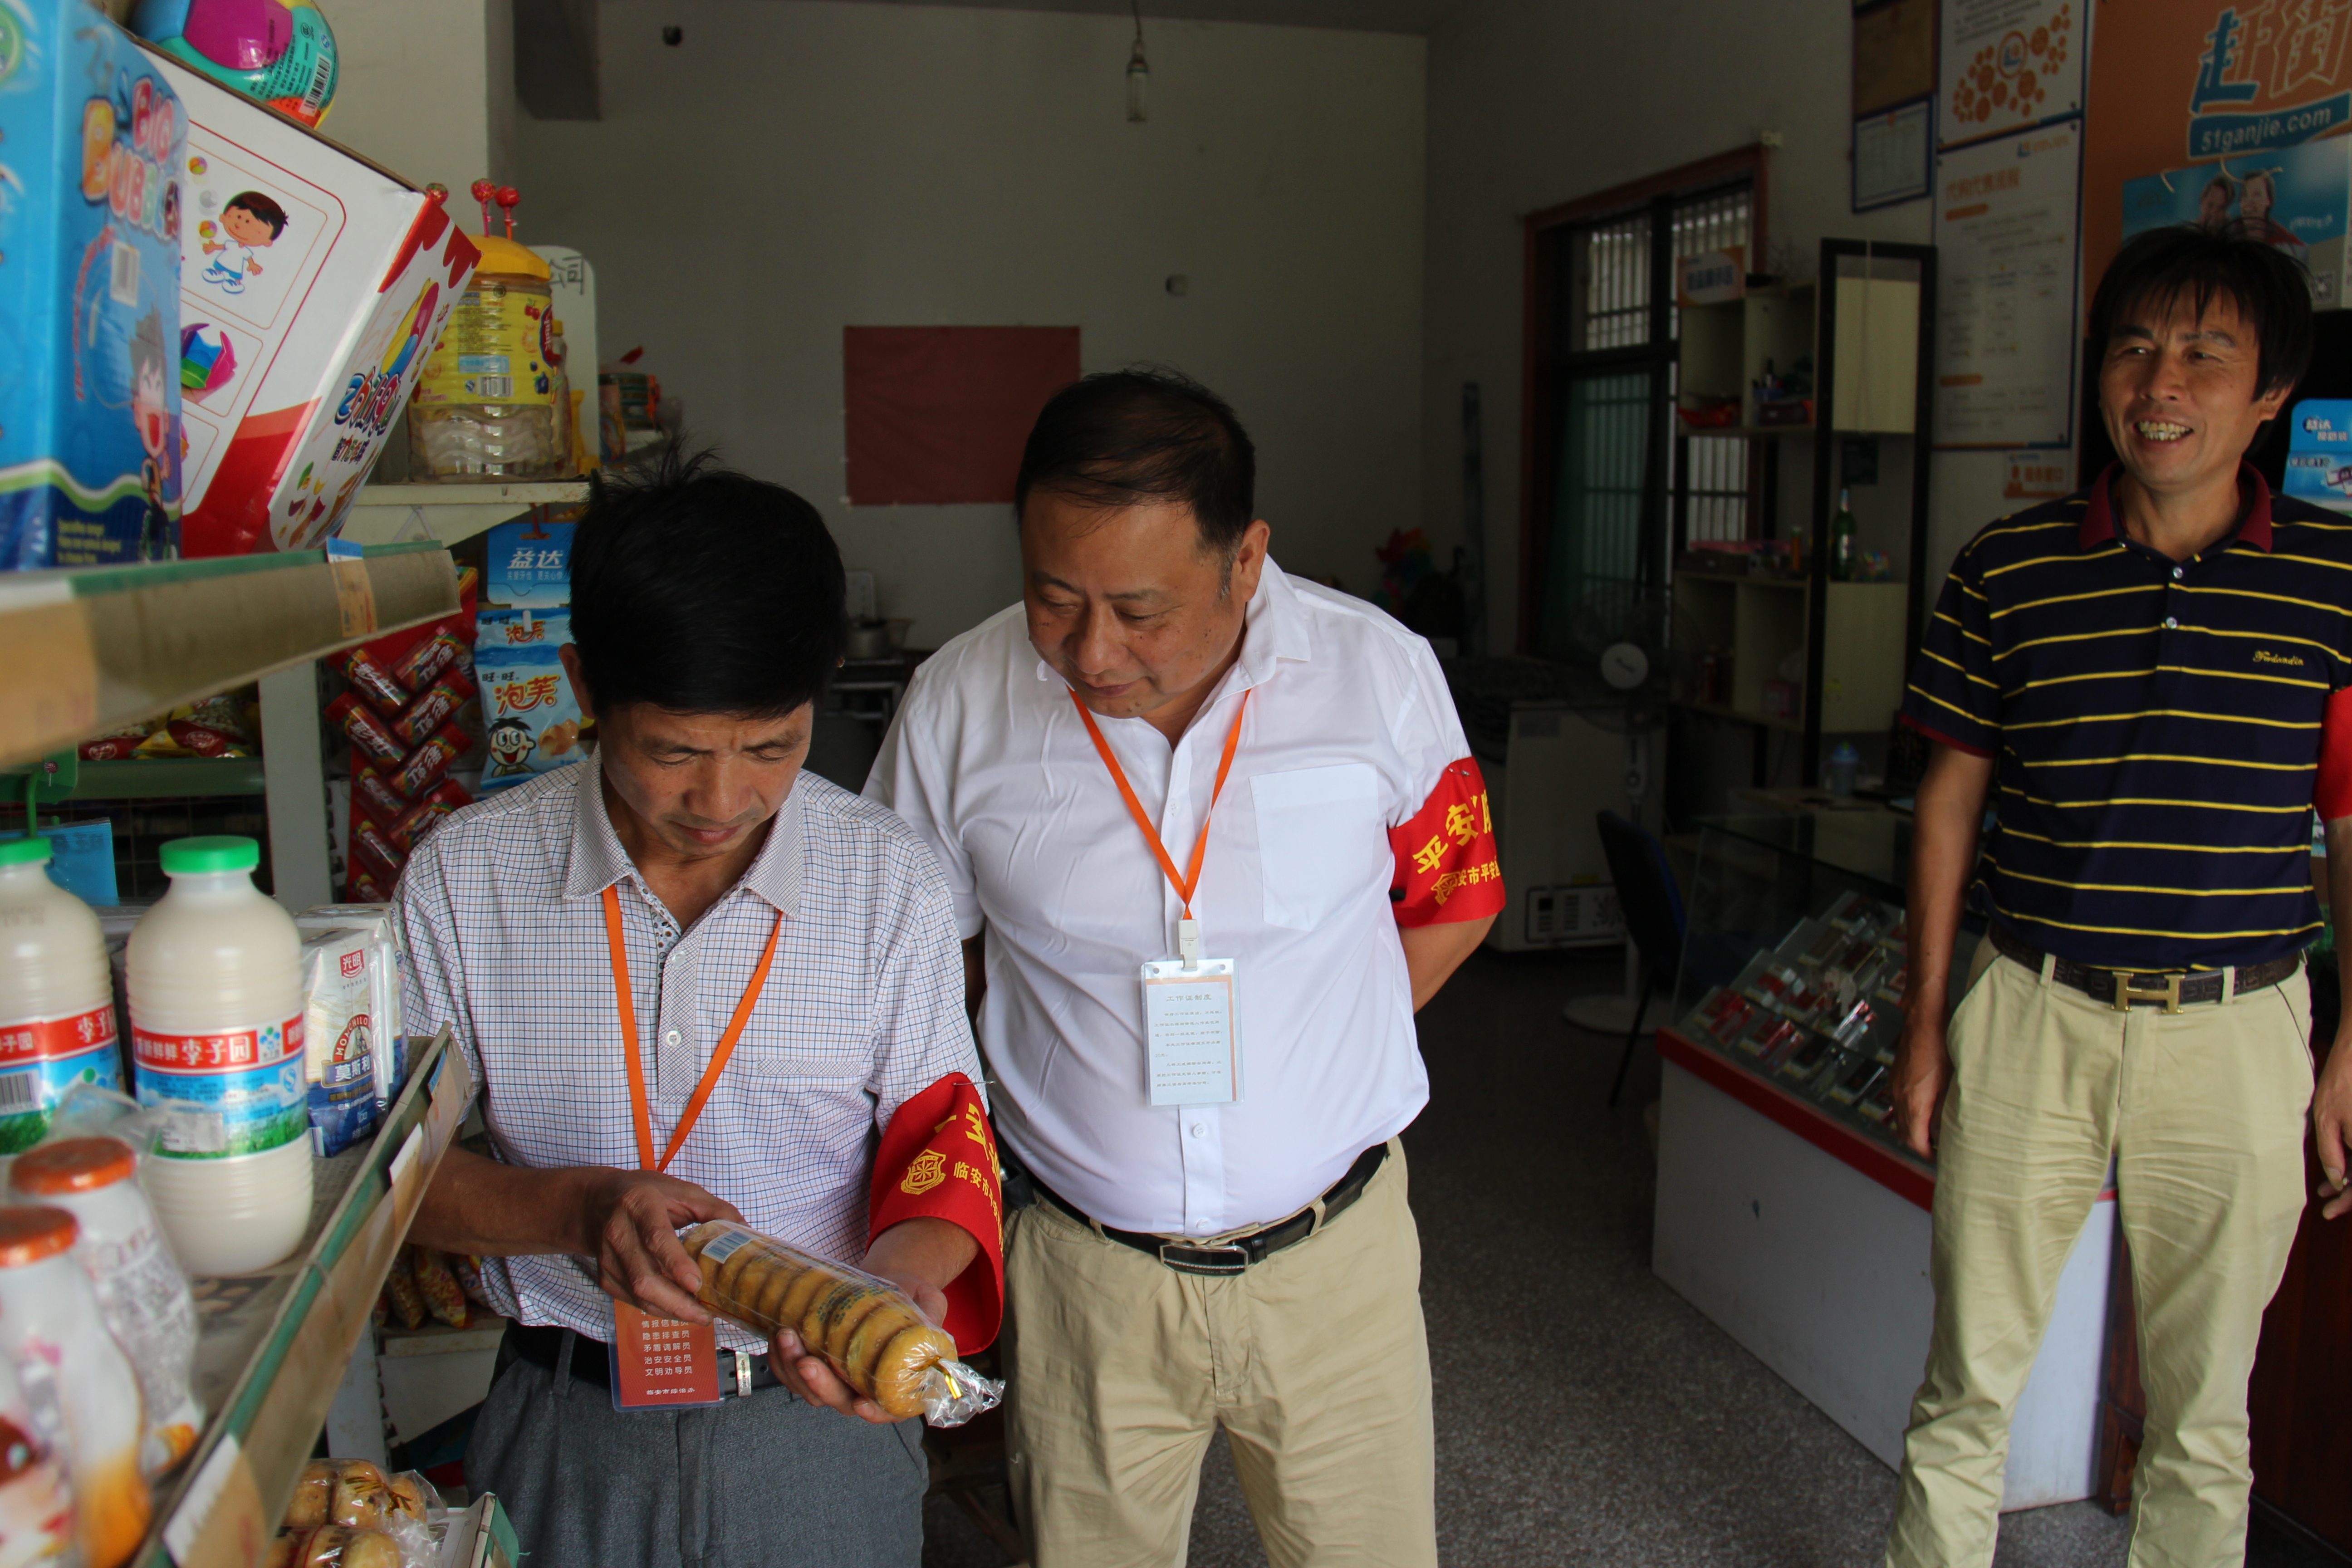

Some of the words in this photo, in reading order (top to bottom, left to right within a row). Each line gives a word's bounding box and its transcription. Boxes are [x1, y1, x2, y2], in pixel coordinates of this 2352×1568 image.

[2202, 108, 2332, 152] 51ganjie.com
[507, 550, 564, 569] 益达
[494, 675, 560, 716] 泡芙
[343, 952, 362, 971] 光明
[1166, 994, 1212, 1002] 工作证制度
[76, 1006, 115, 1044] 李子
[0, 1032, 34, 1053] 子园
[181, 1035, 251, 1066] 李子园
[335, 1054, 371, 1082] 莫斯利
[642, 1330, 690, 1341] 隐患排查员
[644, 1342, 691, 1352] 矛盾调解员
[644, 1354, 692, 1365] 治安安全员
[645, 1366, 693, 1377] 文明劝导员
[646, 1387, 696, 1396] 临安市综治办
